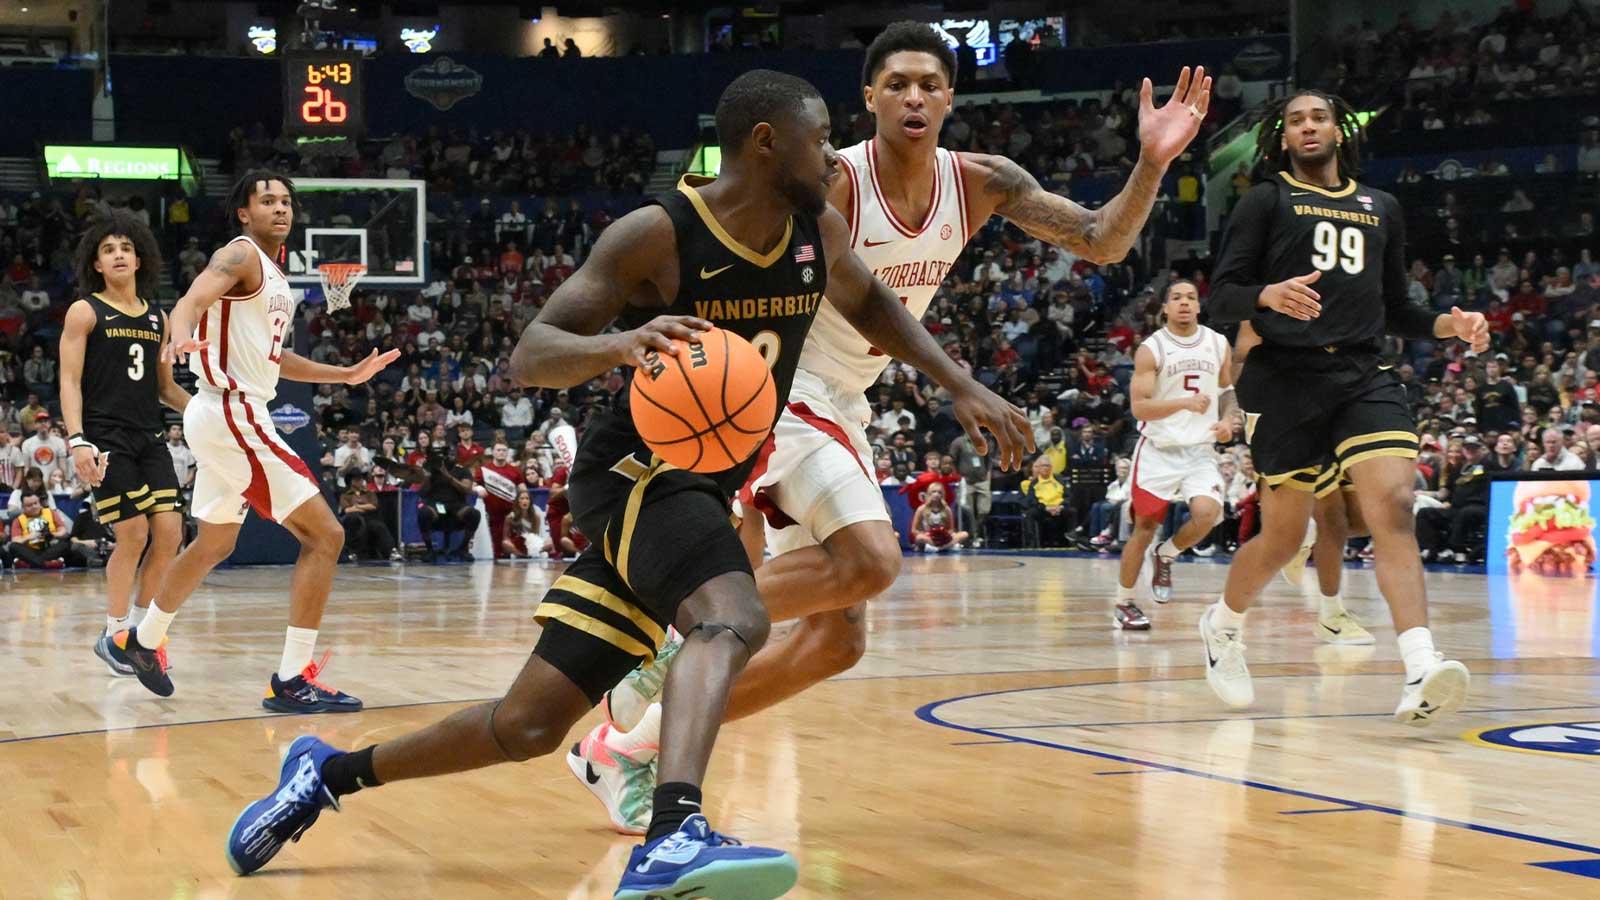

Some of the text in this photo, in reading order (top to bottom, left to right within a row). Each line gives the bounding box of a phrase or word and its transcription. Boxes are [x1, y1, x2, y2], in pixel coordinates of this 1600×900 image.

[308, 63, 352, 85] 6:43
[302, 86, 347, 123] 26
[87, 157, 169, 175] REGIONS
[1293, 204, 1380, 227] VANDERBILT
[1311, 220, 1365, 275] 99
[695, 292, 820, 321] VANDERBILT
[105, 327, 161, 343] VANDERBILT
[127, 343, 144, 381] 3
[1183, 374, 1200, 394] 5
